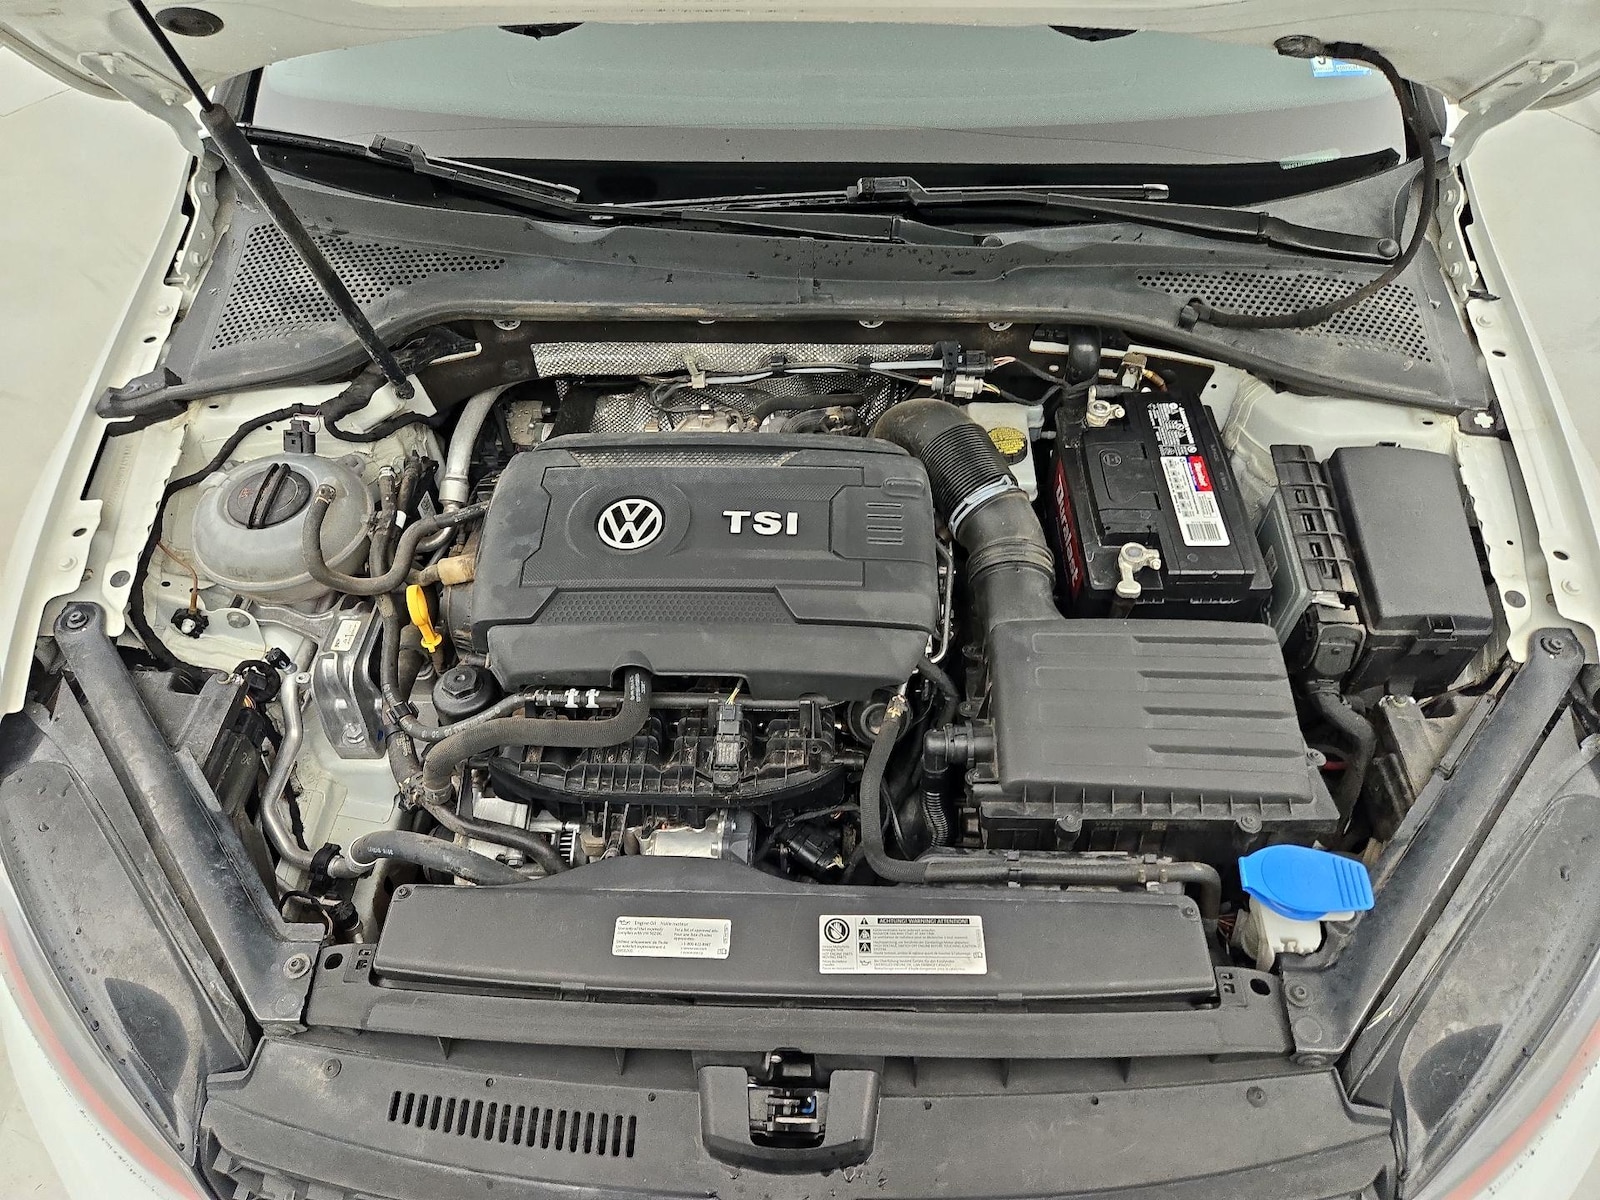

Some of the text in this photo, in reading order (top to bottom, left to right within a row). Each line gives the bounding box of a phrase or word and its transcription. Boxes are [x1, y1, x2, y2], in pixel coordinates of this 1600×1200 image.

[598, 499, 663, 549] VW
[722, 511, 799, 535] TSI
[1056, 474, 1079, 587] Duralast
